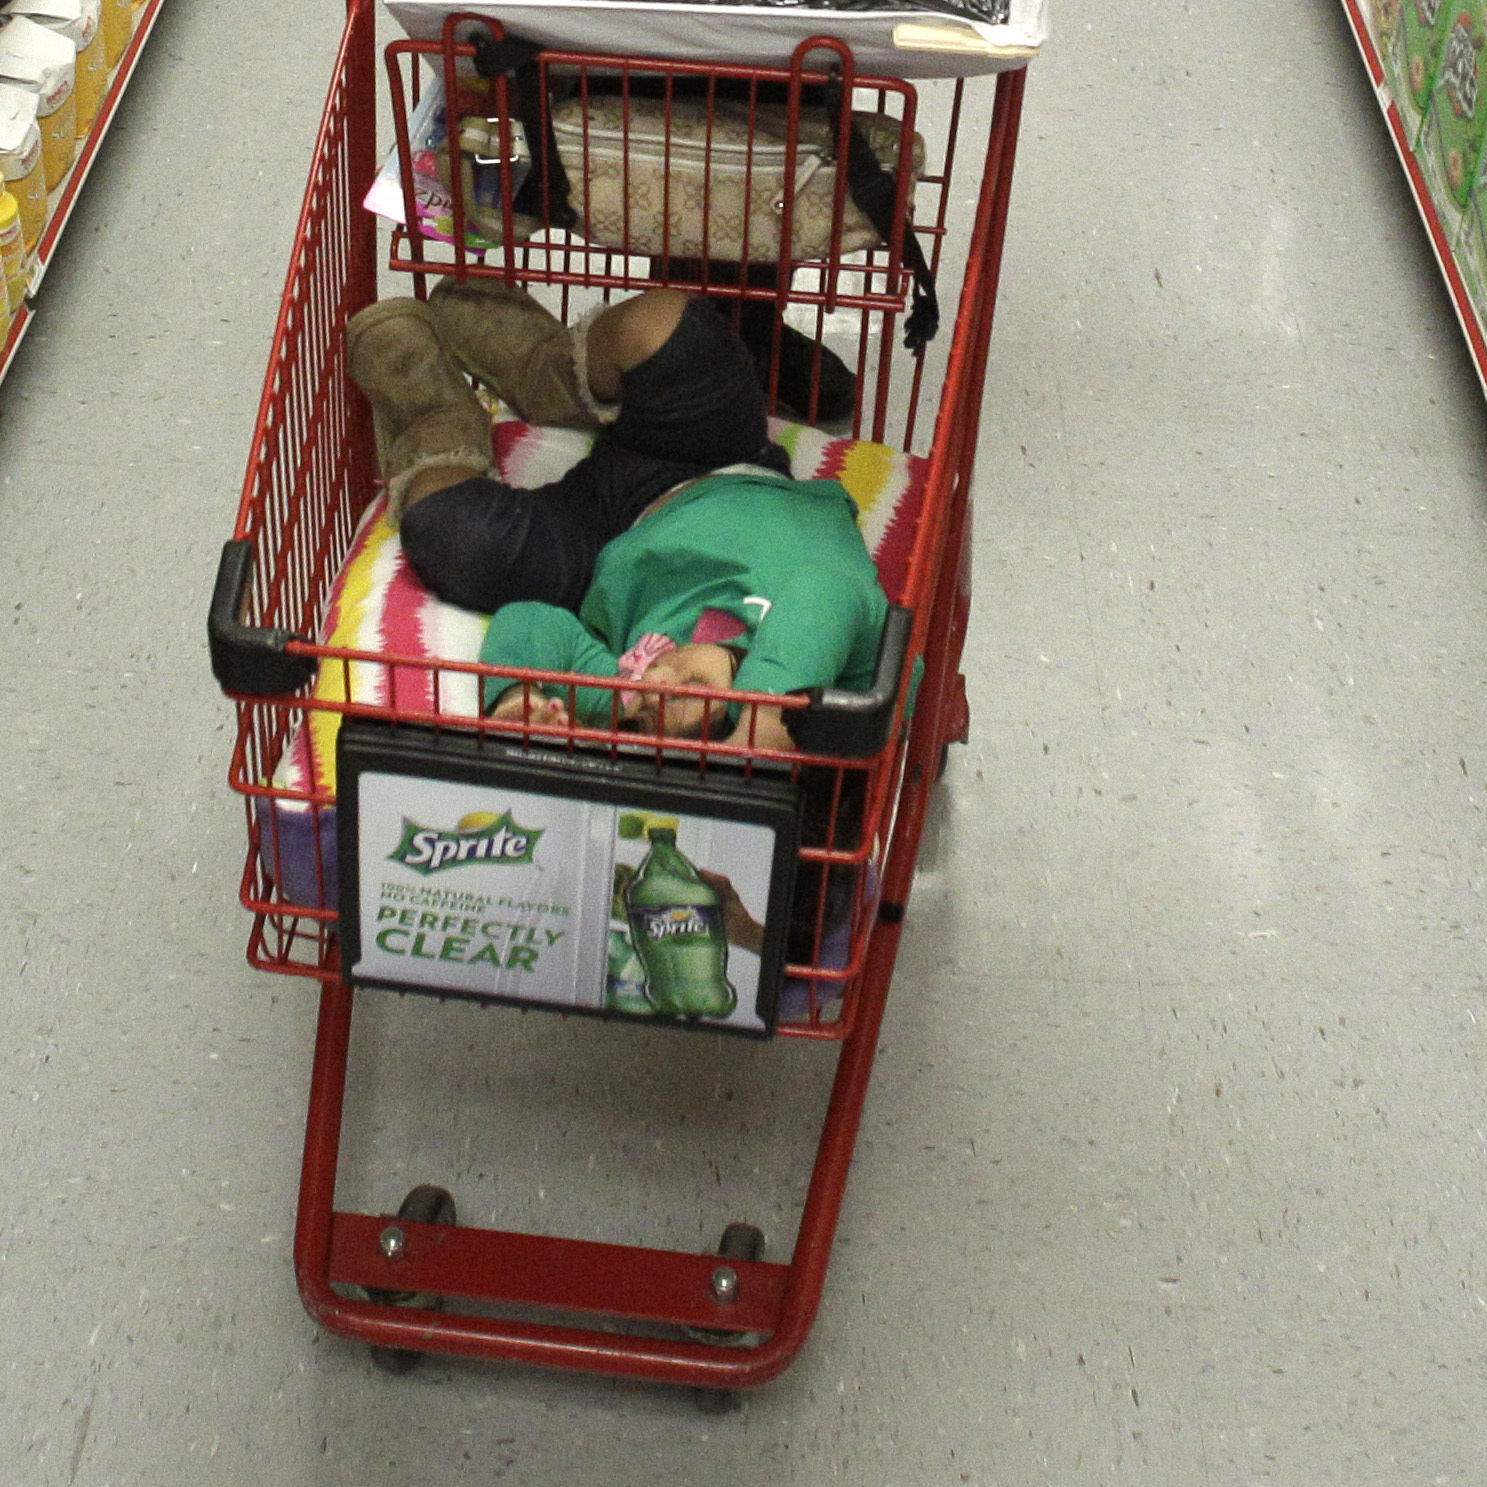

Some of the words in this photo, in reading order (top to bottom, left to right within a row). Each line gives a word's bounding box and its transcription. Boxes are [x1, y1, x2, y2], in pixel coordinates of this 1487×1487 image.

[404, 825, 529, 874] Sprite
[380, 891, 400, 904] NO
[402, 894, 485, 913] CAFFEINE
[418, 885, 492, 907] NATURAL
[497, 896, 570, 917] FLAVORS
[377, 905, 566, 948] PERFECTLY
[648, 913, 706, 940] Sprite
[374, 928, 540, 974] CLEAR
